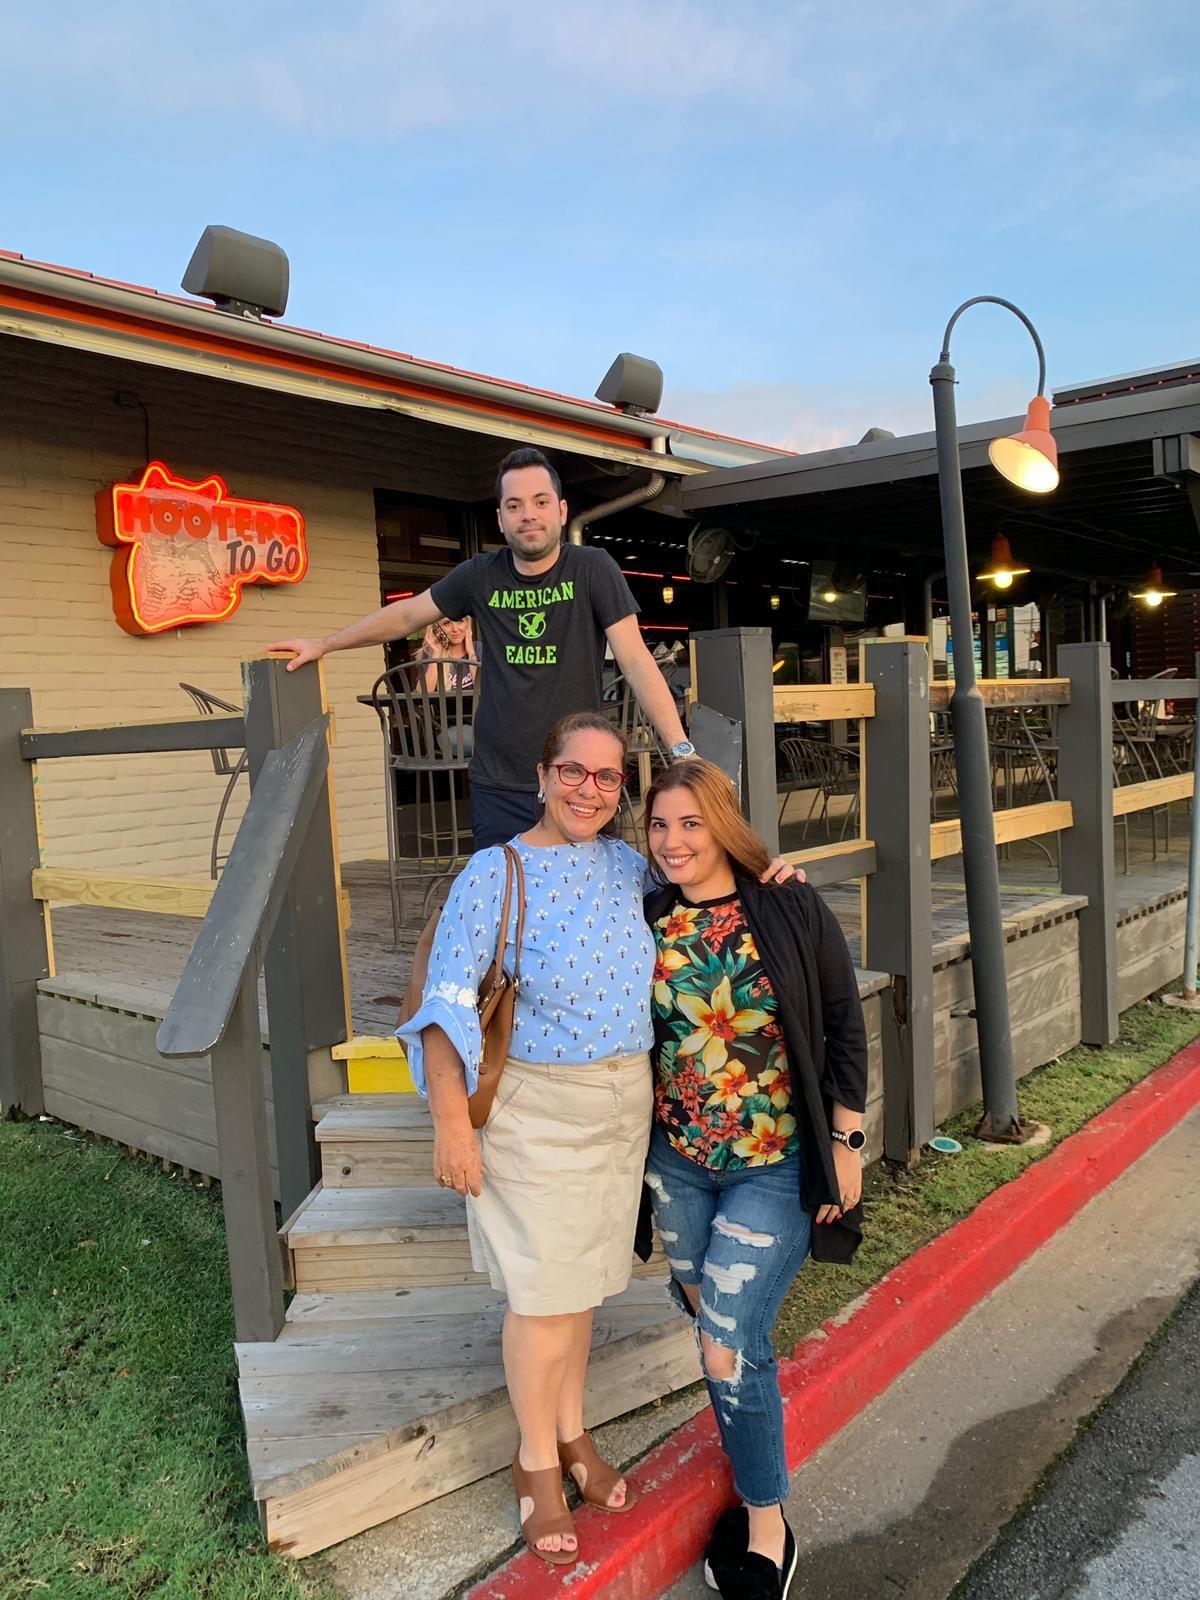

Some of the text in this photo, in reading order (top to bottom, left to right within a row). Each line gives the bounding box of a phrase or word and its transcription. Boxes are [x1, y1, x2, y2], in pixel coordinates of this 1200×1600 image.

[117, 494, 298, 546] HOOTERS
[227, 540, 299, 575] TO GO
[488, 581, 574, 608] AMERICAN
[506, 645, 557, 664] EAGLE
